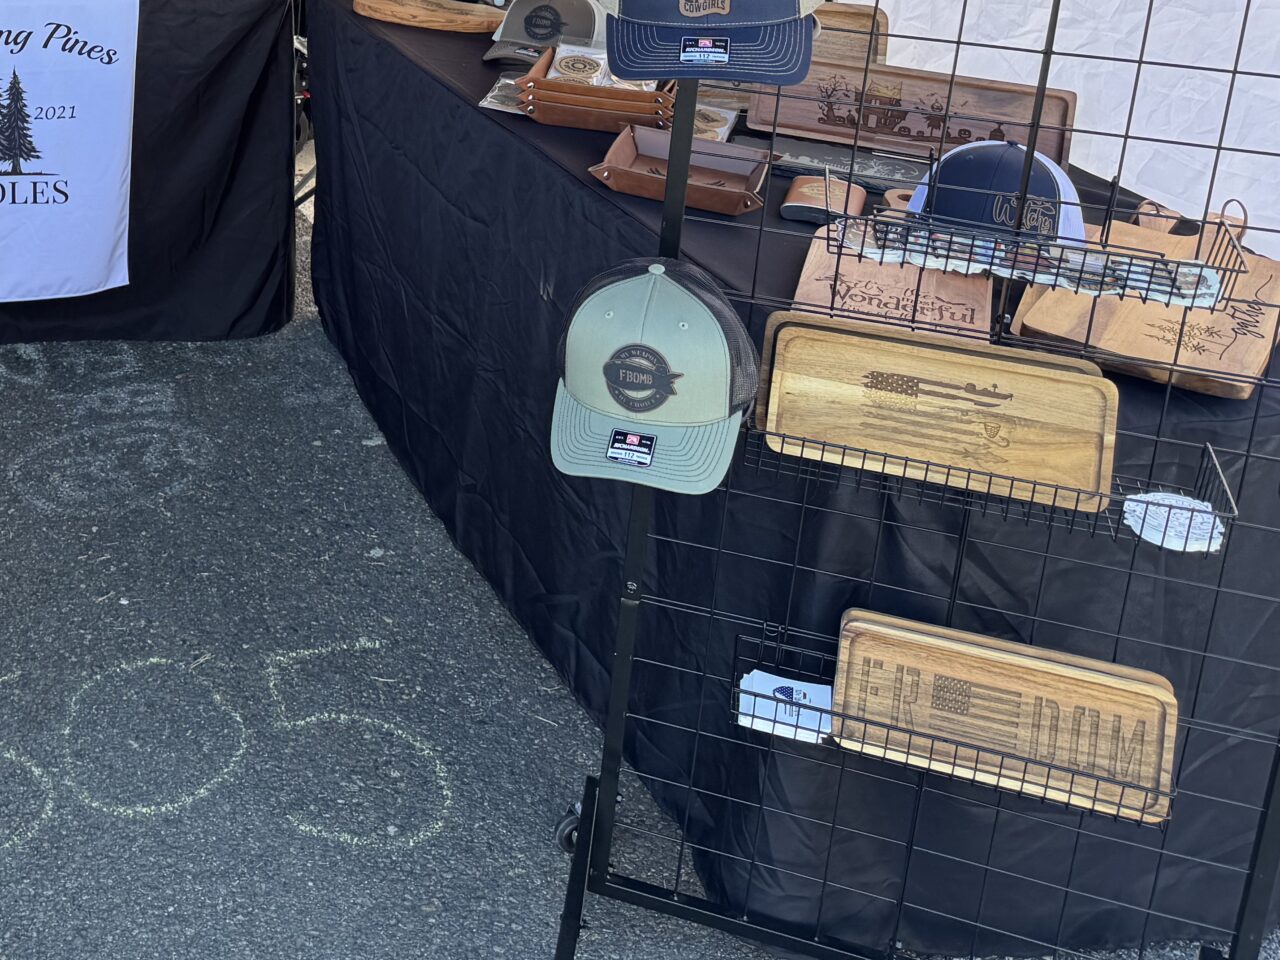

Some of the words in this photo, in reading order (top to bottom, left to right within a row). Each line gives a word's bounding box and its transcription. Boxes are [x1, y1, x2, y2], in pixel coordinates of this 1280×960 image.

[683, 0, 726, 13] COWGIRLS
[41, 21, 120, 66] Pines
[33, 105, 78, 121] 2021
[829, 283, 976, 325] Wonderful
[619, 368, 653, 385] FBOMB
[623, 451, 635, 459] 112
